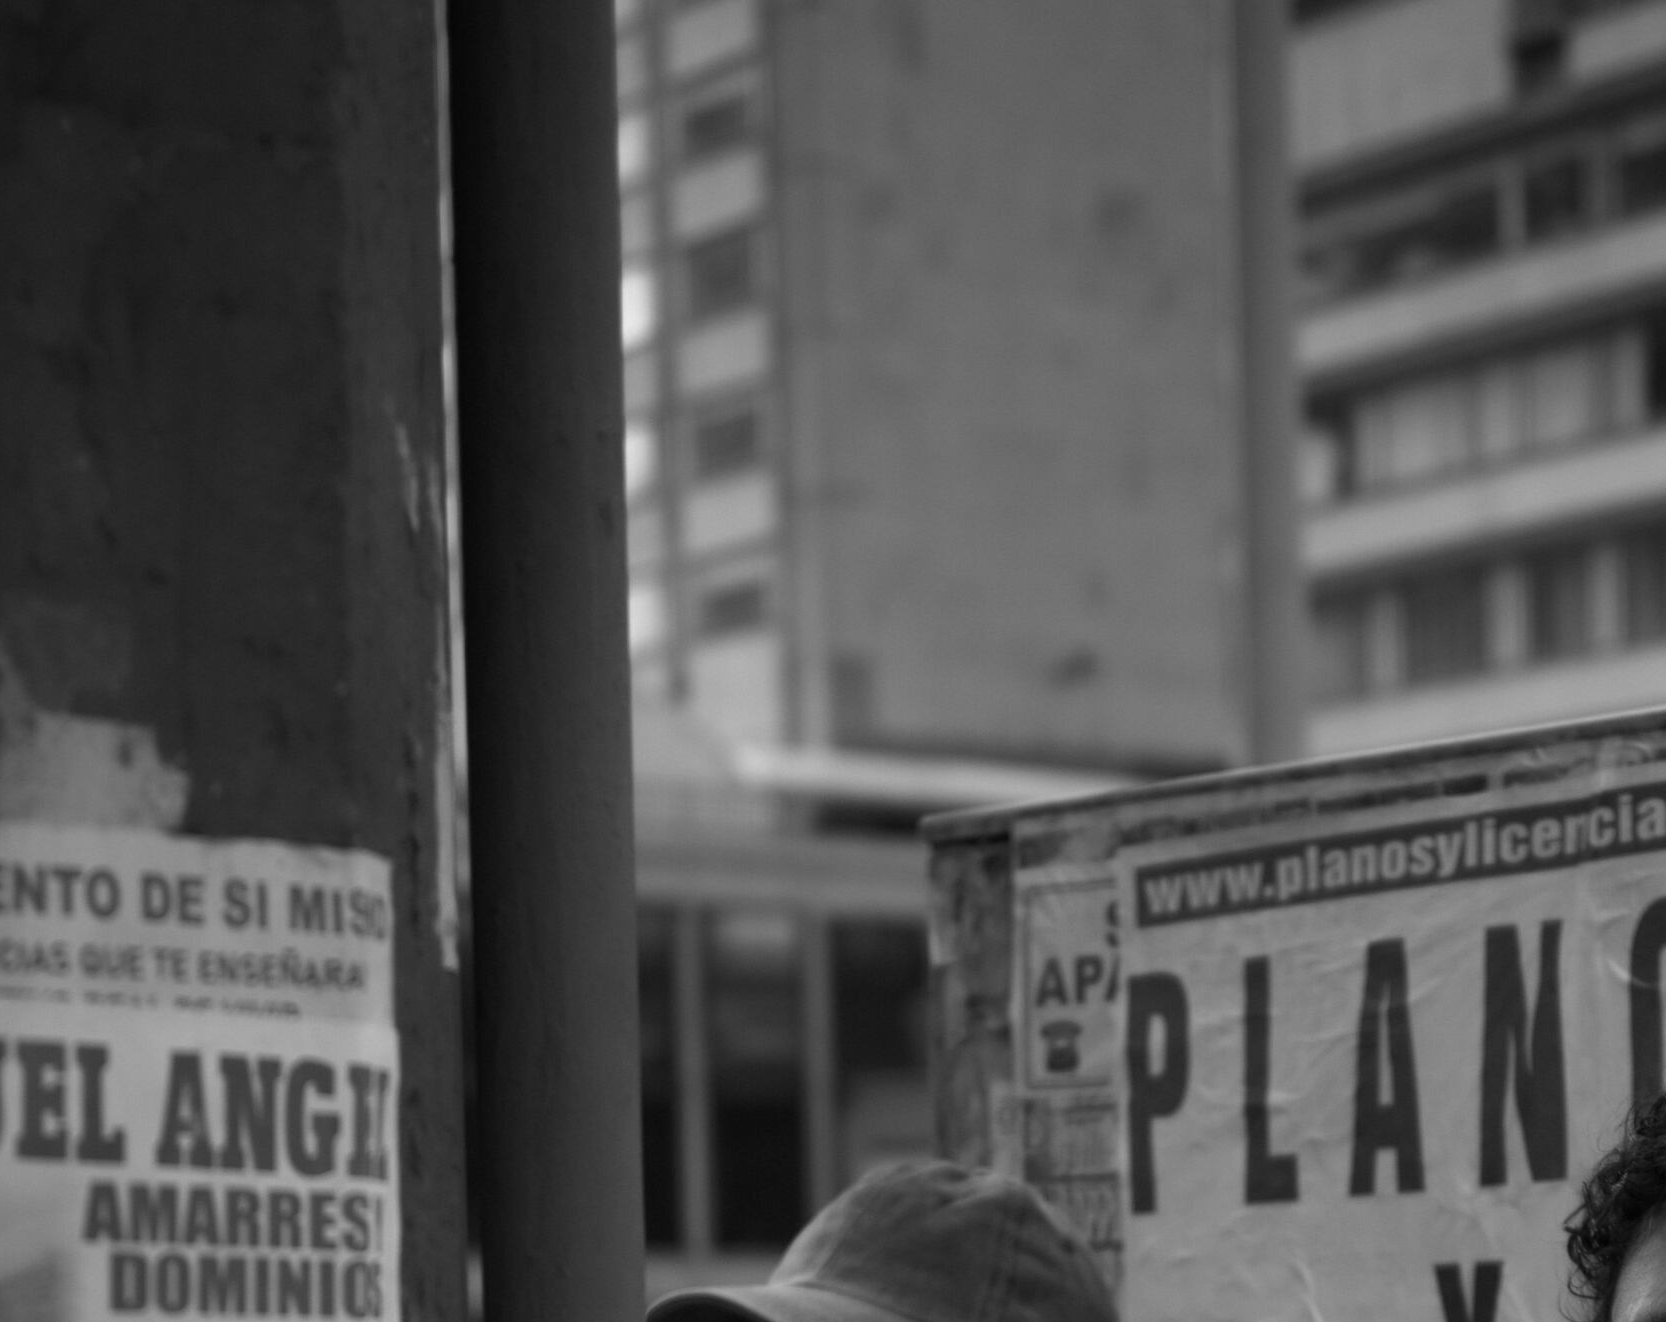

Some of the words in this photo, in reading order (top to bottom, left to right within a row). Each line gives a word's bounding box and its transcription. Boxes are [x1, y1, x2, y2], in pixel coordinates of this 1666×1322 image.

[142, 872, 205, 926] DE
[223, 880, 268, 930] SI
[80, 942, 143, 984] QUE
[155, 945, 188, 985] TE
[82, 1181, 371, 1252] AMARRES
